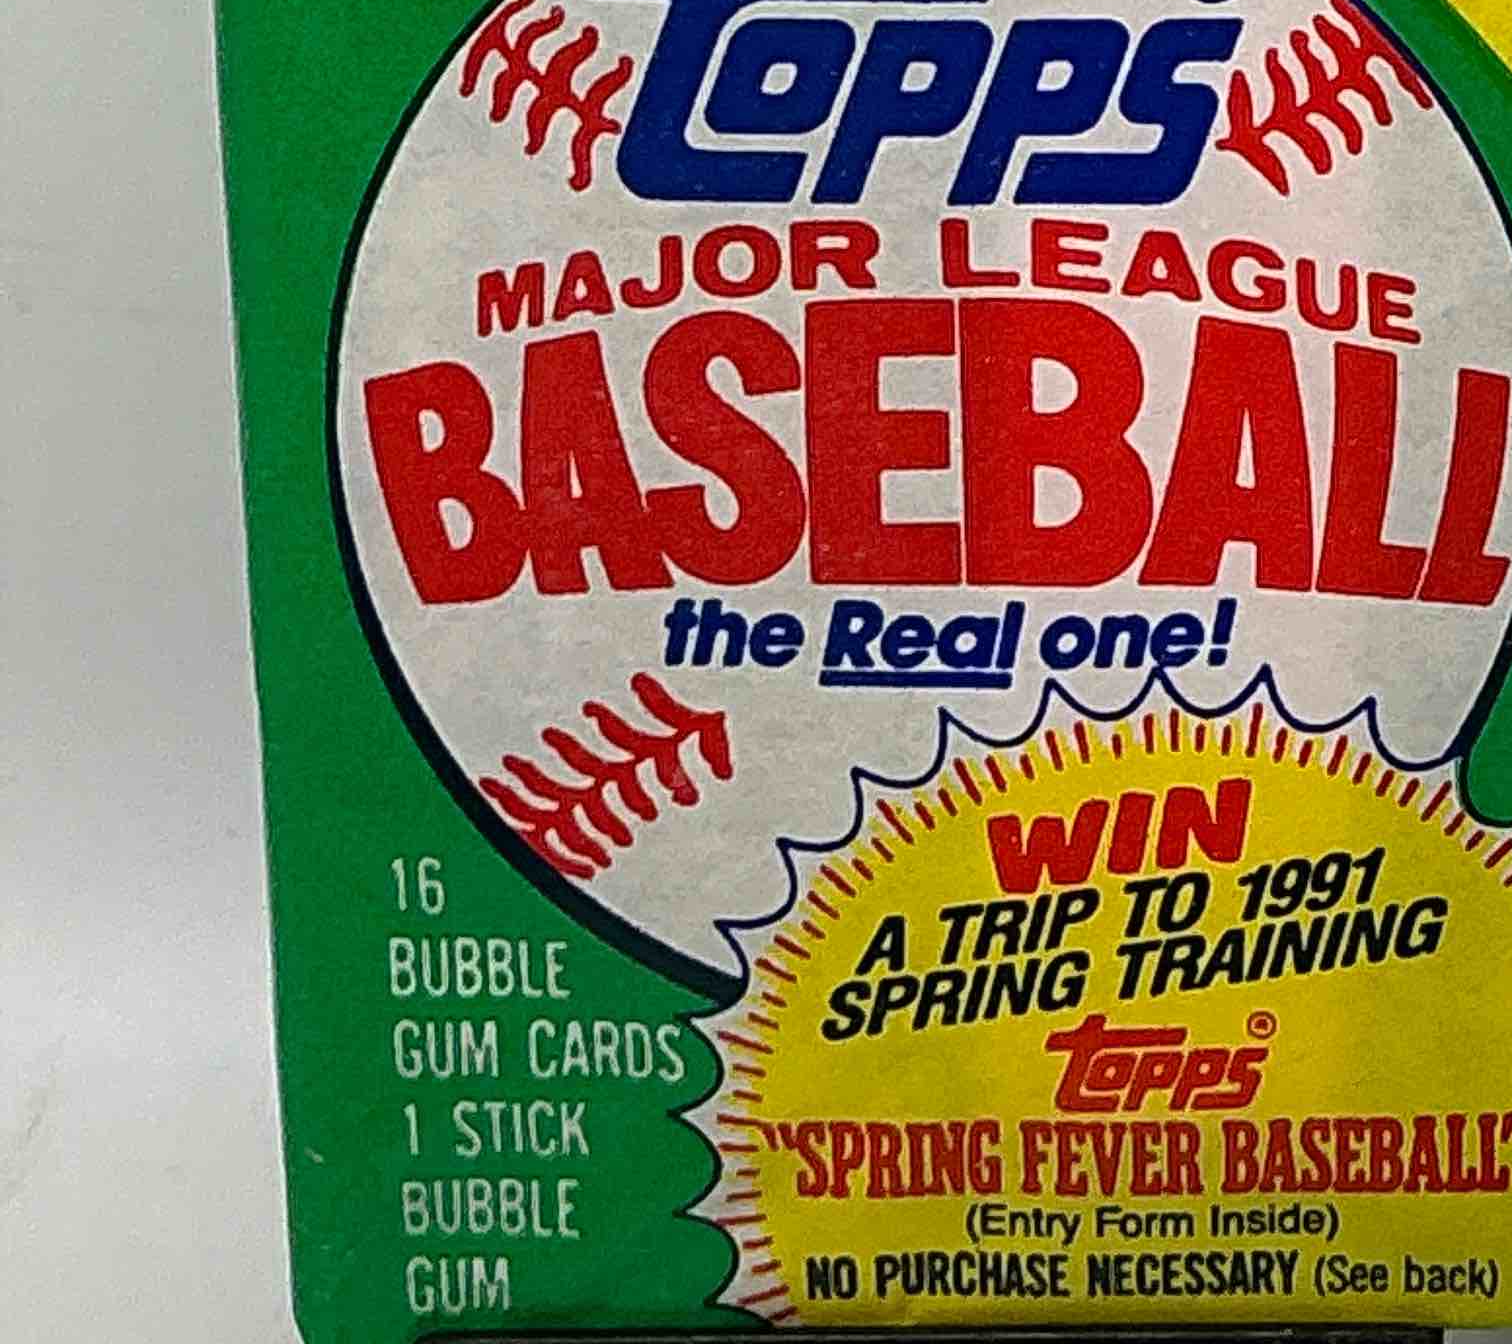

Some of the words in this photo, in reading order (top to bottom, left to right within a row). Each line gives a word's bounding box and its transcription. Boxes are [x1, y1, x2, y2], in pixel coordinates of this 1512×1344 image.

[477, 218, 880, 336] MAJOR
[940, 218, 1420, 344] LEAGUE
[363, 296, 1511, 606] BASEBALL
[664, 598, 804, 667] the
[820, 599, 1025, 688] Real
[1039, 598, 1237, 669] one!
[987, 778, 1251, 893] WIN
[391, 856, 446, 914] 16
[855, 916, 905, 975] A
[940, 888, 1099, 962] TRIP
[1123, 872, 1210, 937] TO
[1238, 847, 1387, 920] 1991
[389, 937, 571, 999] BUBBLE
[820, 951, 1090, 1041] SPRING
[1116, 896, 1450, 999] TRAINING
[393, 1019, 500, 1079] GUM
[527, 1019, 686, 1082] CARDS
[403, 1102, 420, 1155] 1
[453, 1101, 590, 1157] STICK
[1021, 1119, 1204, 1196] FEVER
[402, 1178, 580, 1239] BUBBLE
[966, 1203, 1080, 1240] (Entry
[1096, 1204, 1195, 1238] Form
[1211, 1203, 1340, 1239] Inside)
[405, 1256, 512, 1313] GUM
[806, 1256, 858, 1299] NO
[876, 1253, 1070, 1297] PURCHASE
[1087, 1250, 1297, 1294] NECESSARY
[1315, 1257, 1389, 1295] (See
[1404, 1257, 1500, 1297] back)
